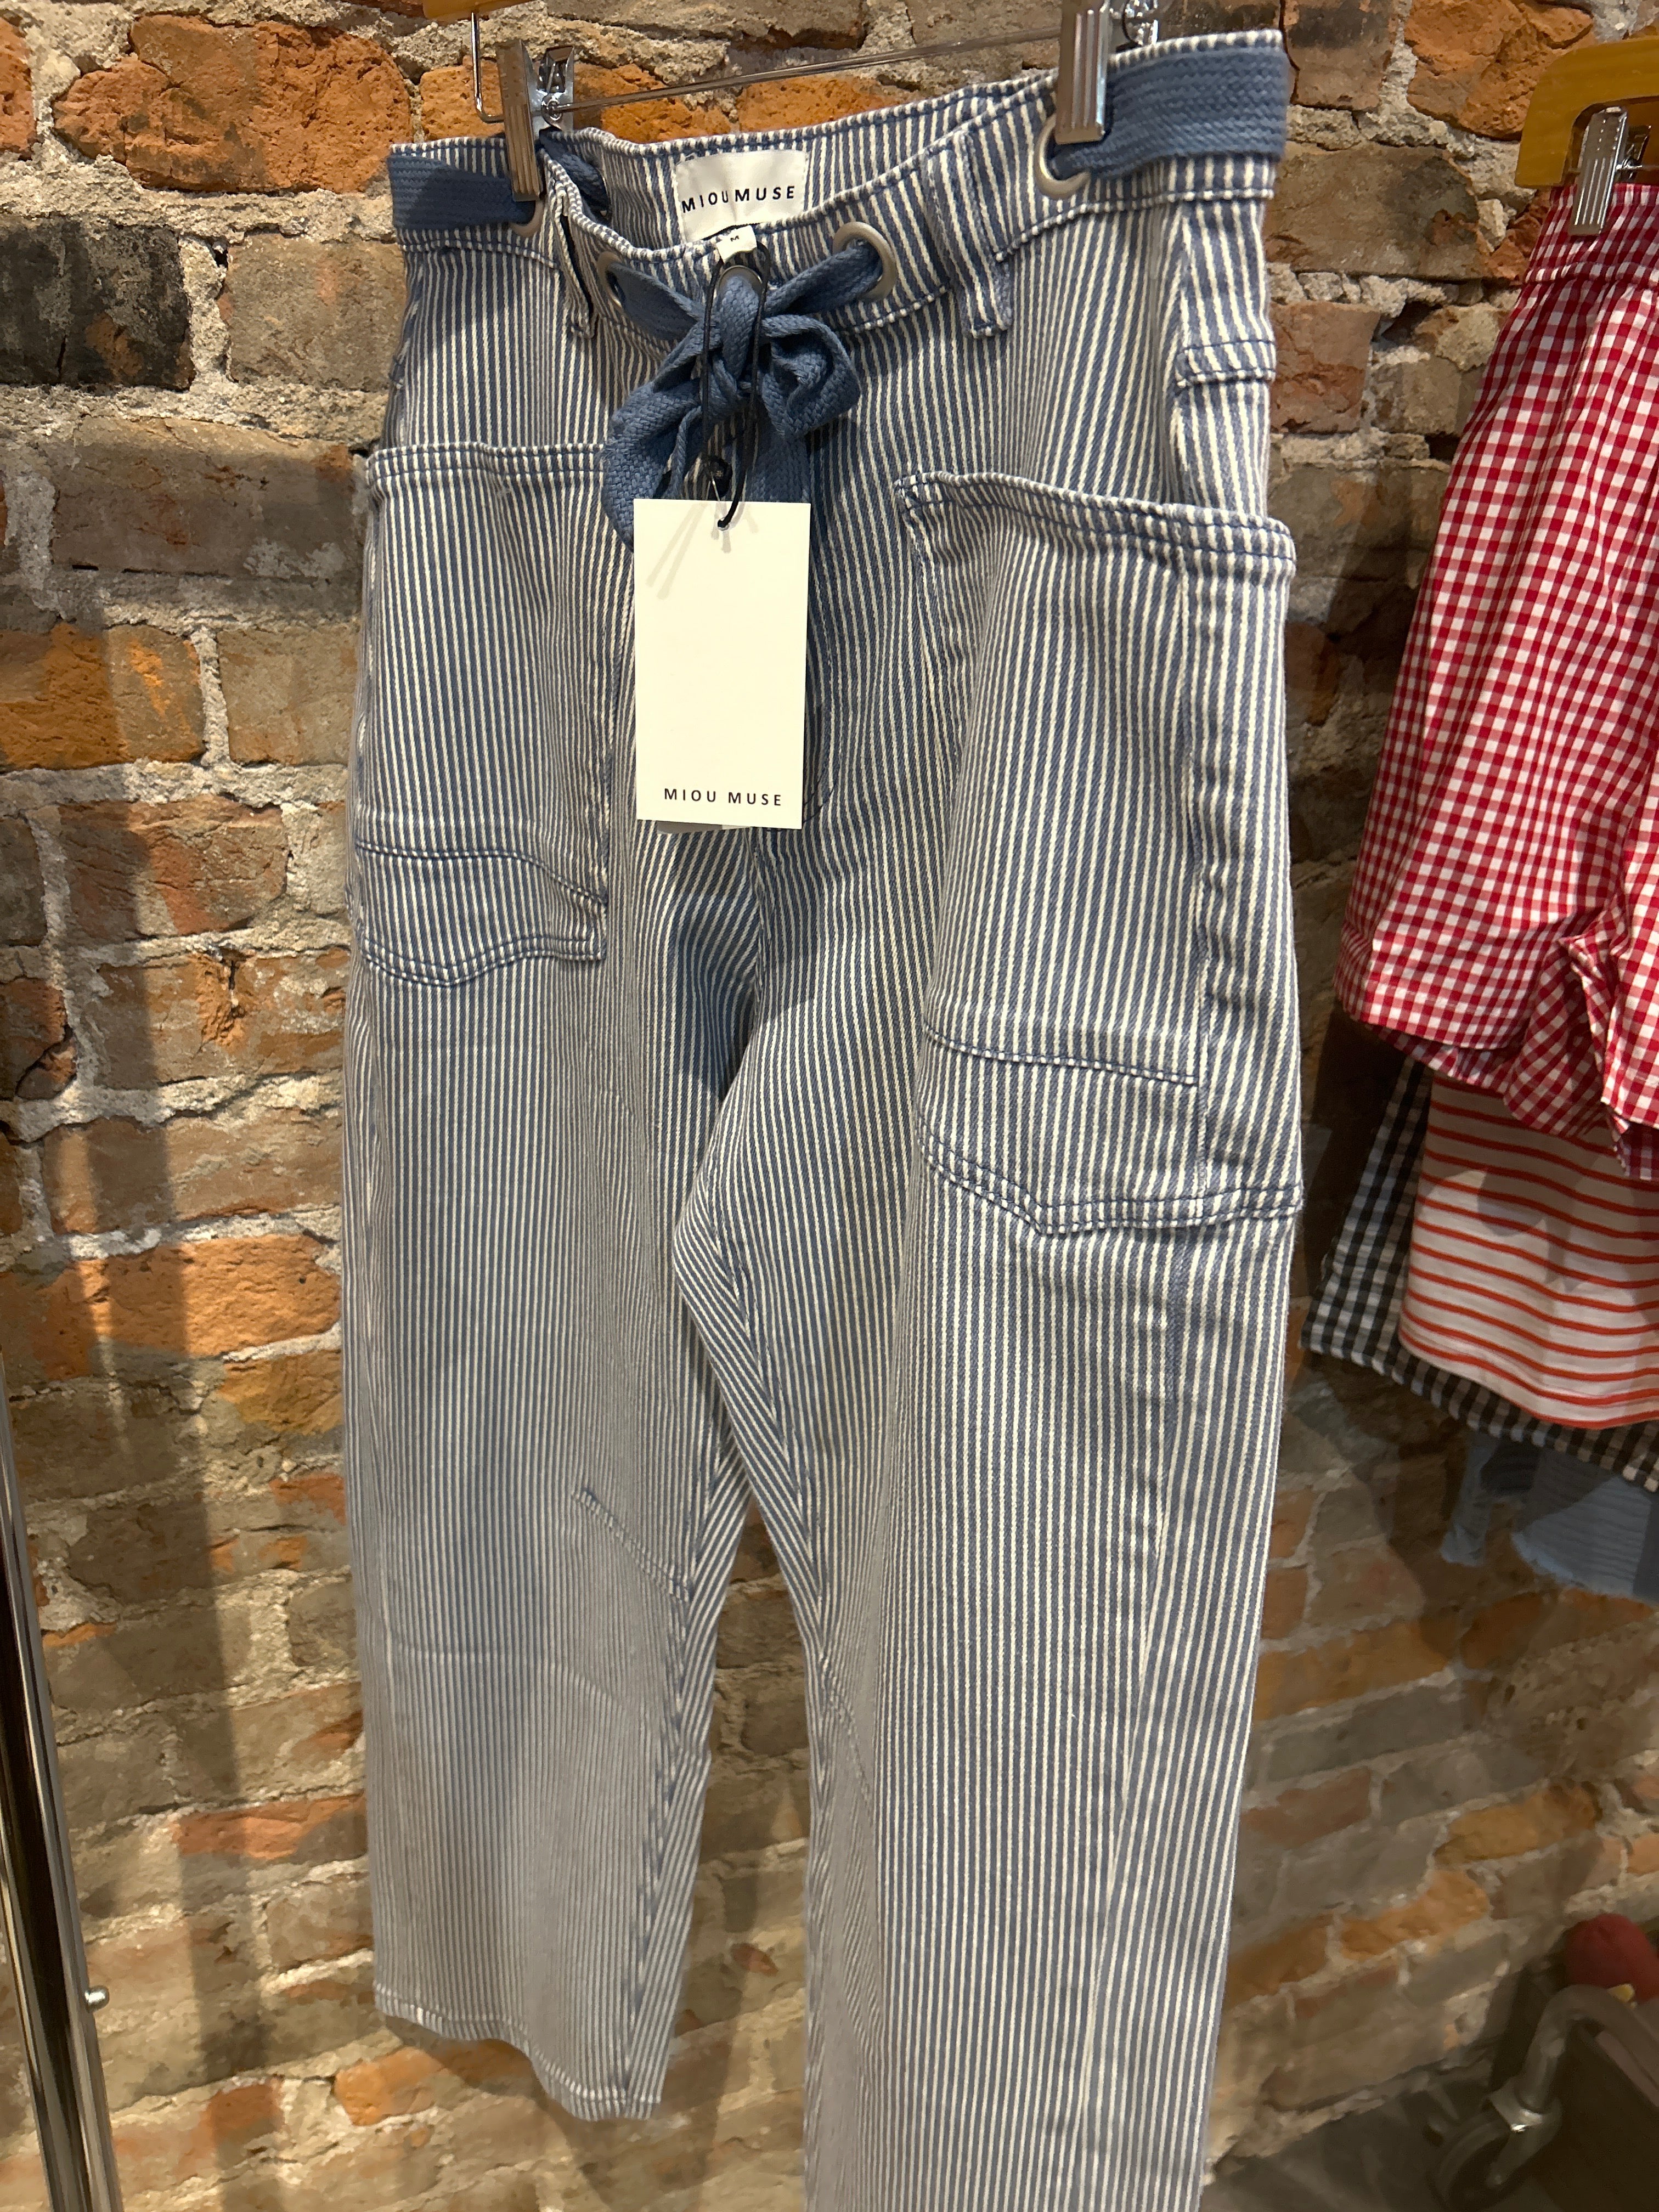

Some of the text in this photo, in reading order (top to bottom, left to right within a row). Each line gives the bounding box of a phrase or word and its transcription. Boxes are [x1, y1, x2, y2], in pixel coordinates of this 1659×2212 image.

[681, 186, 795, 213] MIOU MUSE
[664, 788, 781, 806] MIOU MUSE
